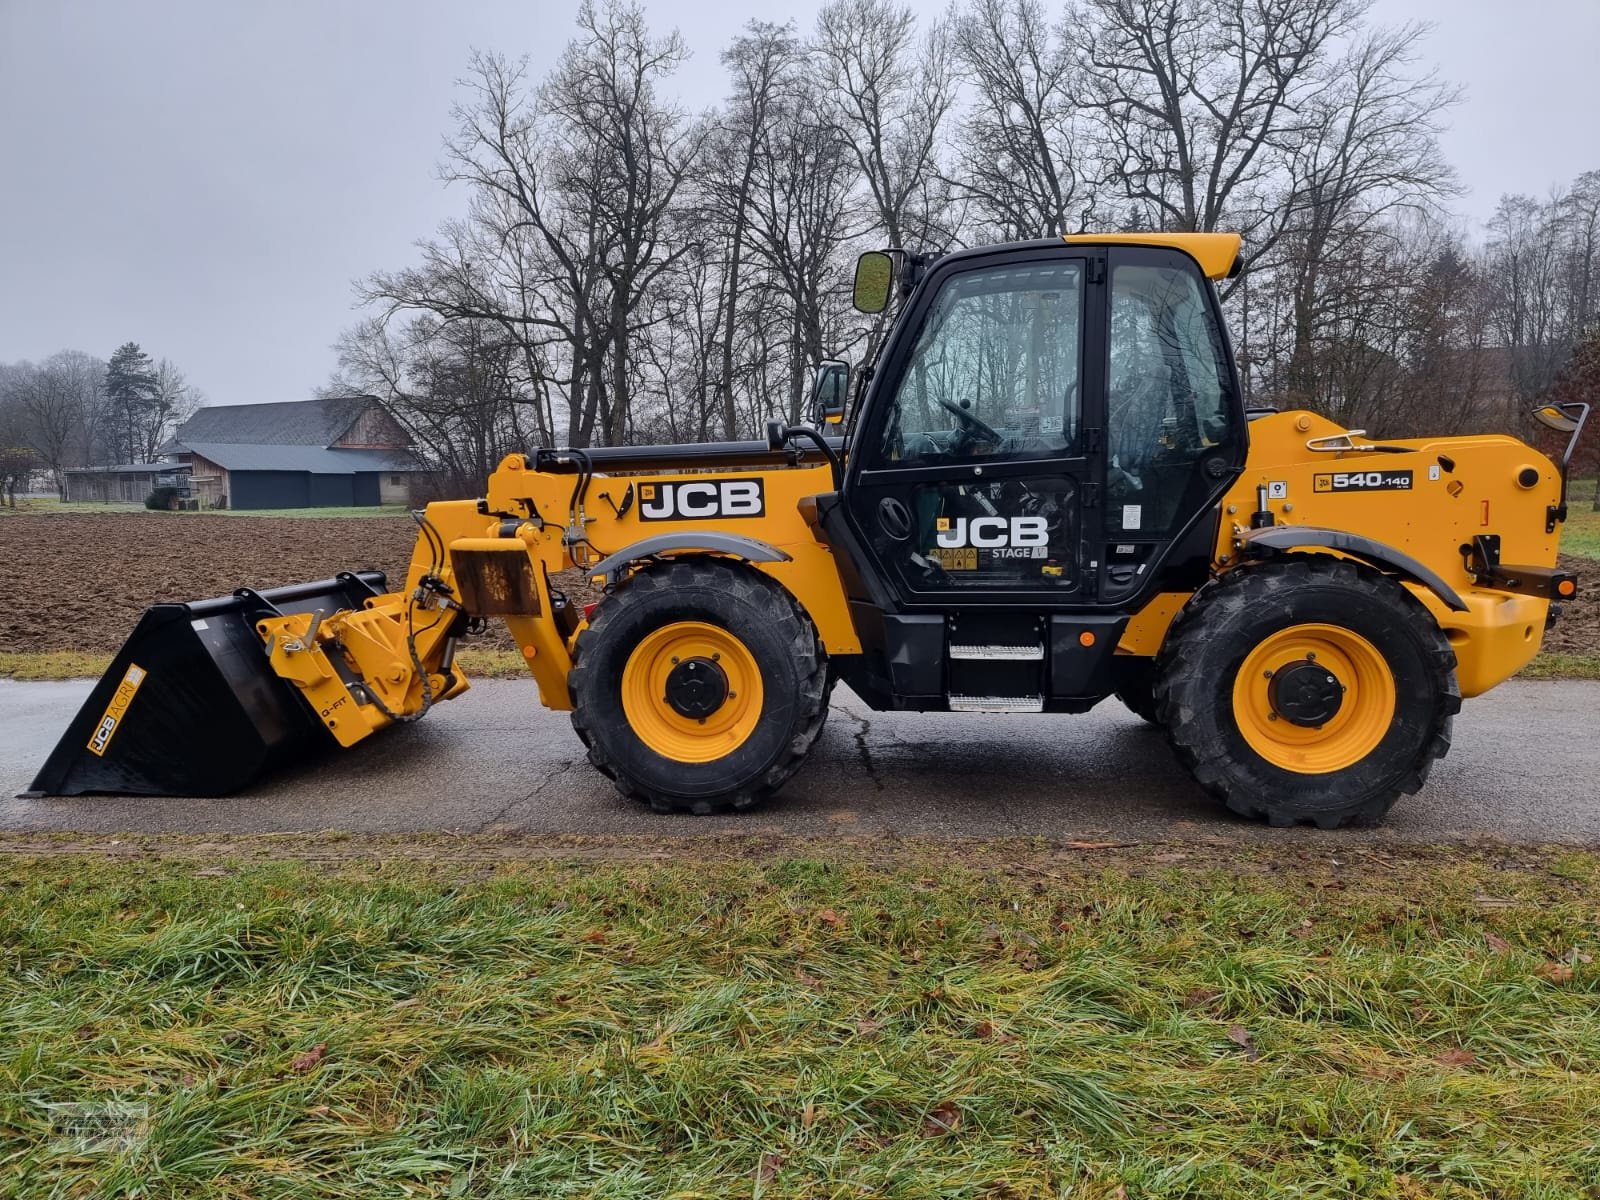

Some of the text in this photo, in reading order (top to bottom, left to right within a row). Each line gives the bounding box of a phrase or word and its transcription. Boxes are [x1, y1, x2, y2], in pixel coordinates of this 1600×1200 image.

[642, 482, 761, 518] JCB
[937, 517, 1049, 548] JCB
[992, 548, 1030, 558] STAGE
[94, 681, 136, 751] JCB AGRI
[321, 695, 346, 717] Q-FIT
